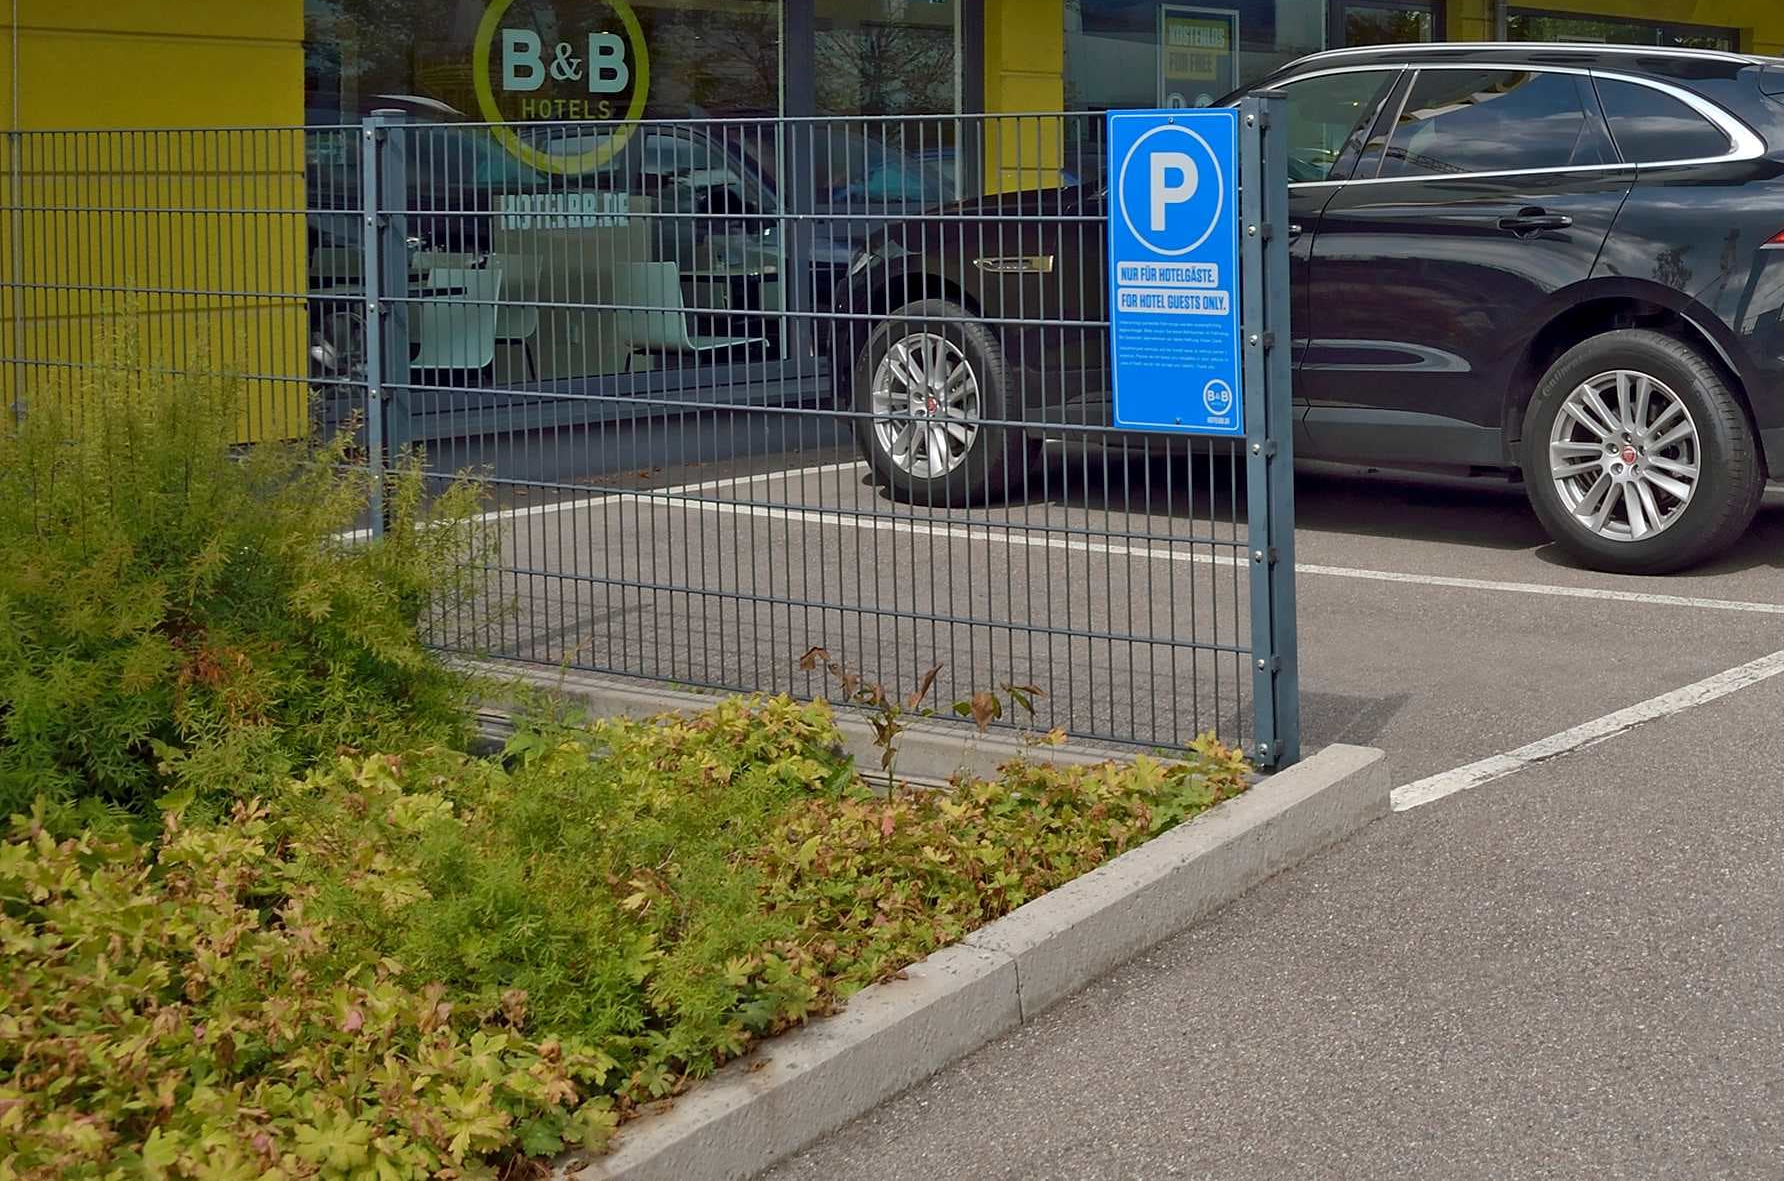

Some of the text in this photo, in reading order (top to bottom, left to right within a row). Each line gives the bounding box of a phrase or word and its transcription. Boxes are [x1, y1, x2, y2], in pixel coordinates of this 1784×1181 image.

[501, 29, 629, 93] B&B
[521, 98, 612, 120] HOTELS
[1150, 151, 1199, 232] P
[1120, 265, 1216, 284] NUR FÜR HOTELGÄSTE.
[1121, 293, 1227, 312] FOR HOTEL GUESTS ONLY.
[1207, 390, 1229, 402] B&B
